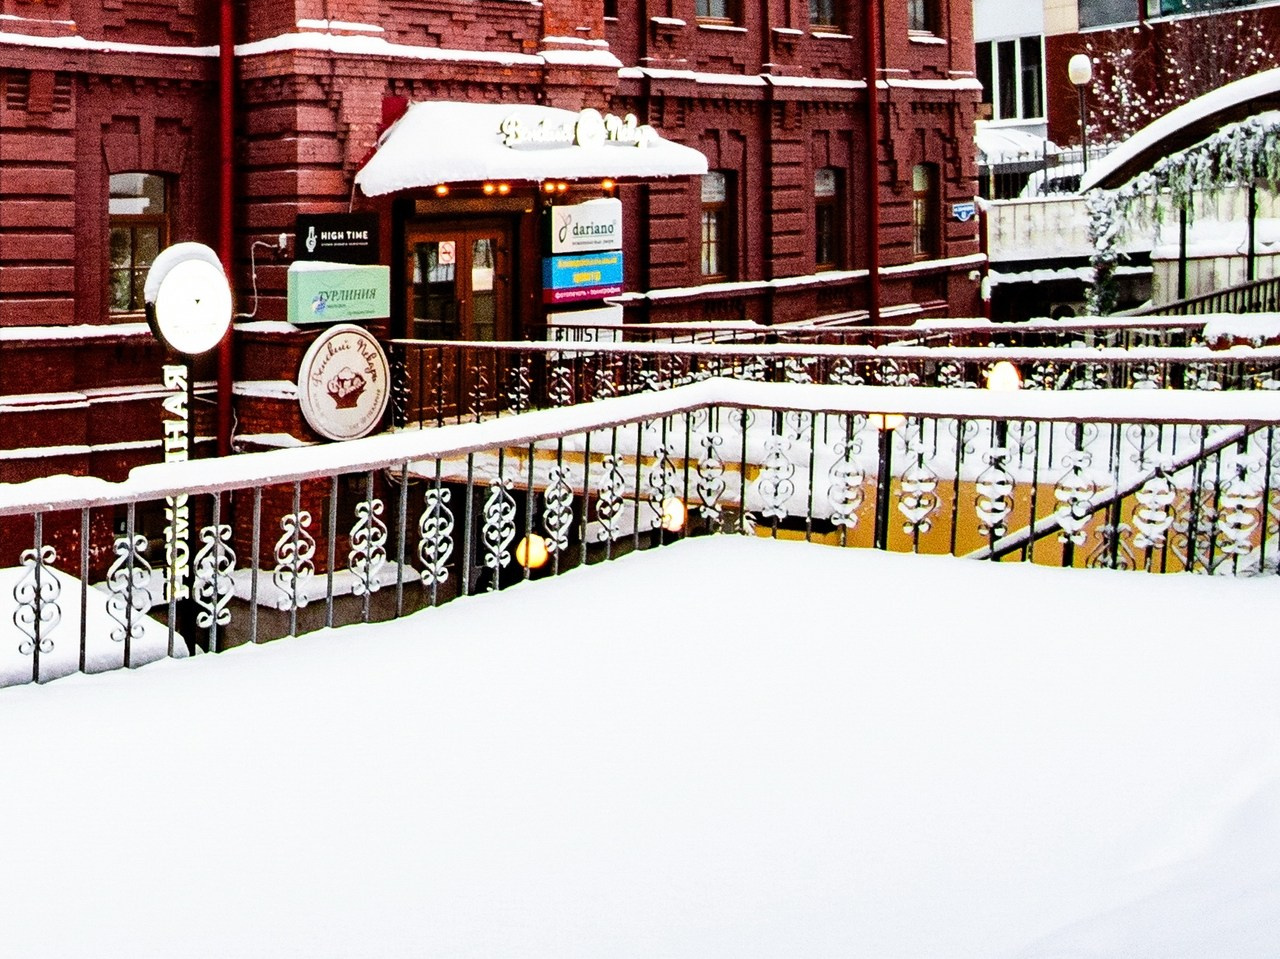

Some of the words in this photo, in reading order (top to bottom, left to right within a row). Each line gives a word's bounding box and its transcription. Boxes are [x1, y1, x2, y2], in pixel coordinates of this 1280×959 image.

[321, 231, 344, 240] HIGH
[346, 230, 368, 240] TIME
[572, 221, 614, 236] dariano
[318, 288, 377, 302] ТУРЛИНИЯ
